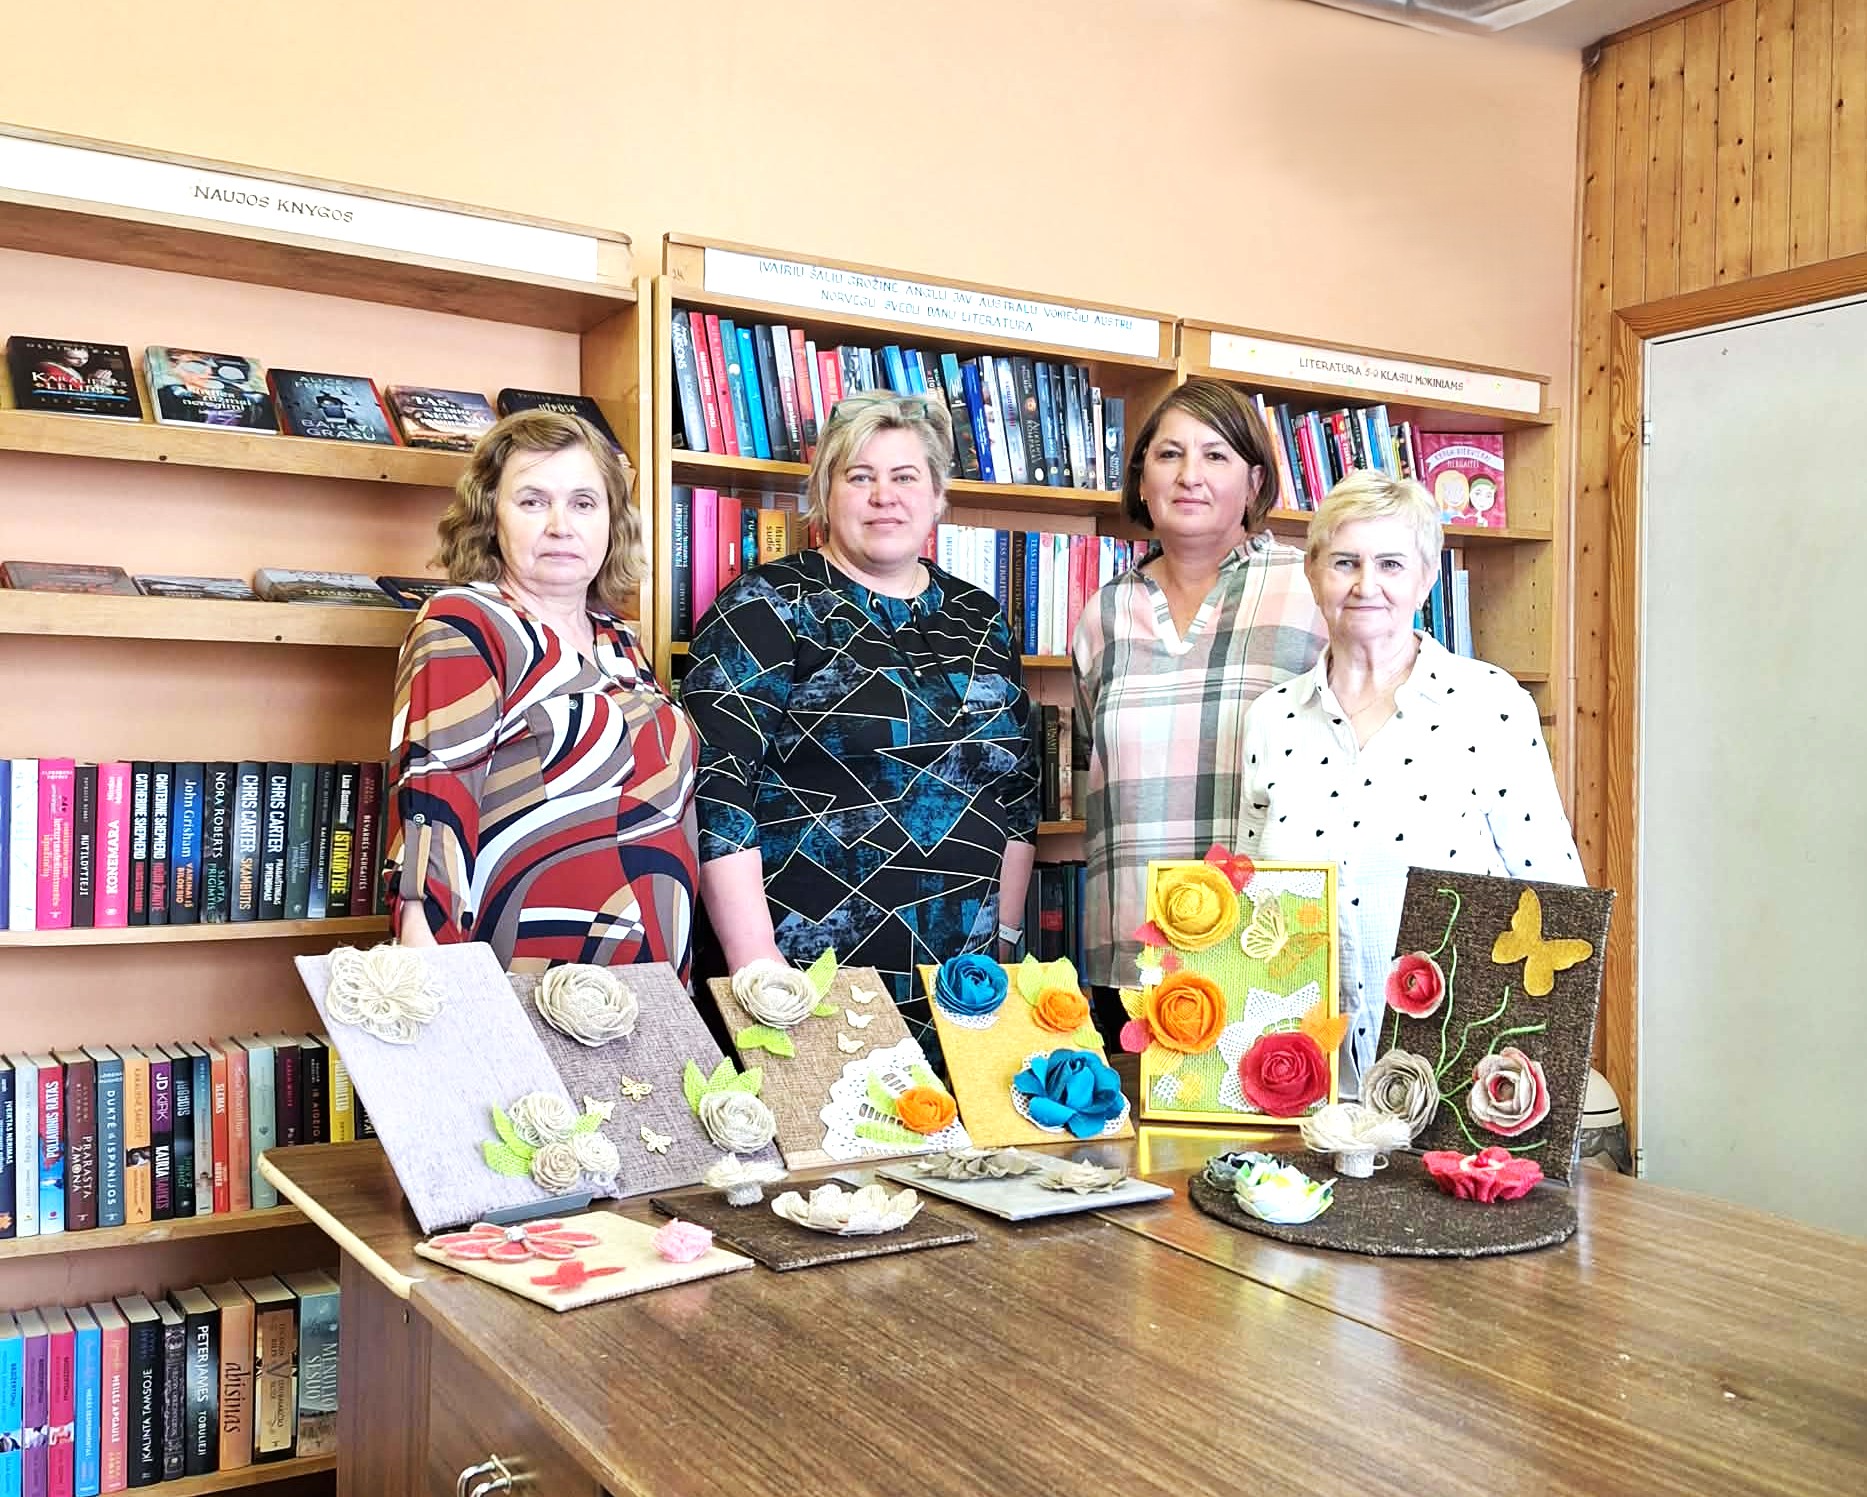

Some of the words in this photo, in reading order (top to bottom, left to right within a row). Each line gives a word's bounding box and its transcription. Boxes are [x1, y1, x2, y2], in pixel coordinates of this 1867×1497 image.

[194, 185, 270, 208] NAUJOS
[277, 199, 353, 223] KNYGOS
[673, 322, 687, 370] MARSONS
[766, 526, 776, 552] sudie
[135, 773, 148, 817] CATHERINE
[155, 773, 168, 817] CHATERINE
[185, 779, 197, 808] John
[215, 772, 226, 804] NORA
[242, 775, 258, 809] CHRIS
[270, 776, 287, 809] CHRIS
[133, 818, 146, 859] SHEPHERD
[153, 818, 167, 859] SHEPHERD
[181, 810, 196, 858] Grisham
[212, 809, 224, 858] ROBERTS
[239, 811, 257, 852] CARTER
[267, 811, 285, 853] CARTER
[106, 819, 120, 895] KONEMARA
[216, 870, 225, 903] SLAPTA
[239, 857, 253, 910] SKAMBUTIS
[45, 1081, 58, 1111] RATAS
[156, 1073, 168, 1090] JD
[156, 1093, 168, 1122] KIRK
[72, 1146, 83, 1192] ŽMONA
[82, 1135, 92, 1199] PRARASTA
[107, 1142, 116, 1205] ISPANIJOS
[197, 1325, 209, 1362] PETER
[142, 1368, 153, 1416] TAMSOJE
[196, 1364, 209, 1403] JAMES
[223, 1362, 250, 1434] abisinas
[305, 1355, 320, 1399] SESUO
[142, 1418, 153, 1463] ĮKALINTA
[197, 1410, 206, 1456] TOBULIEJI
